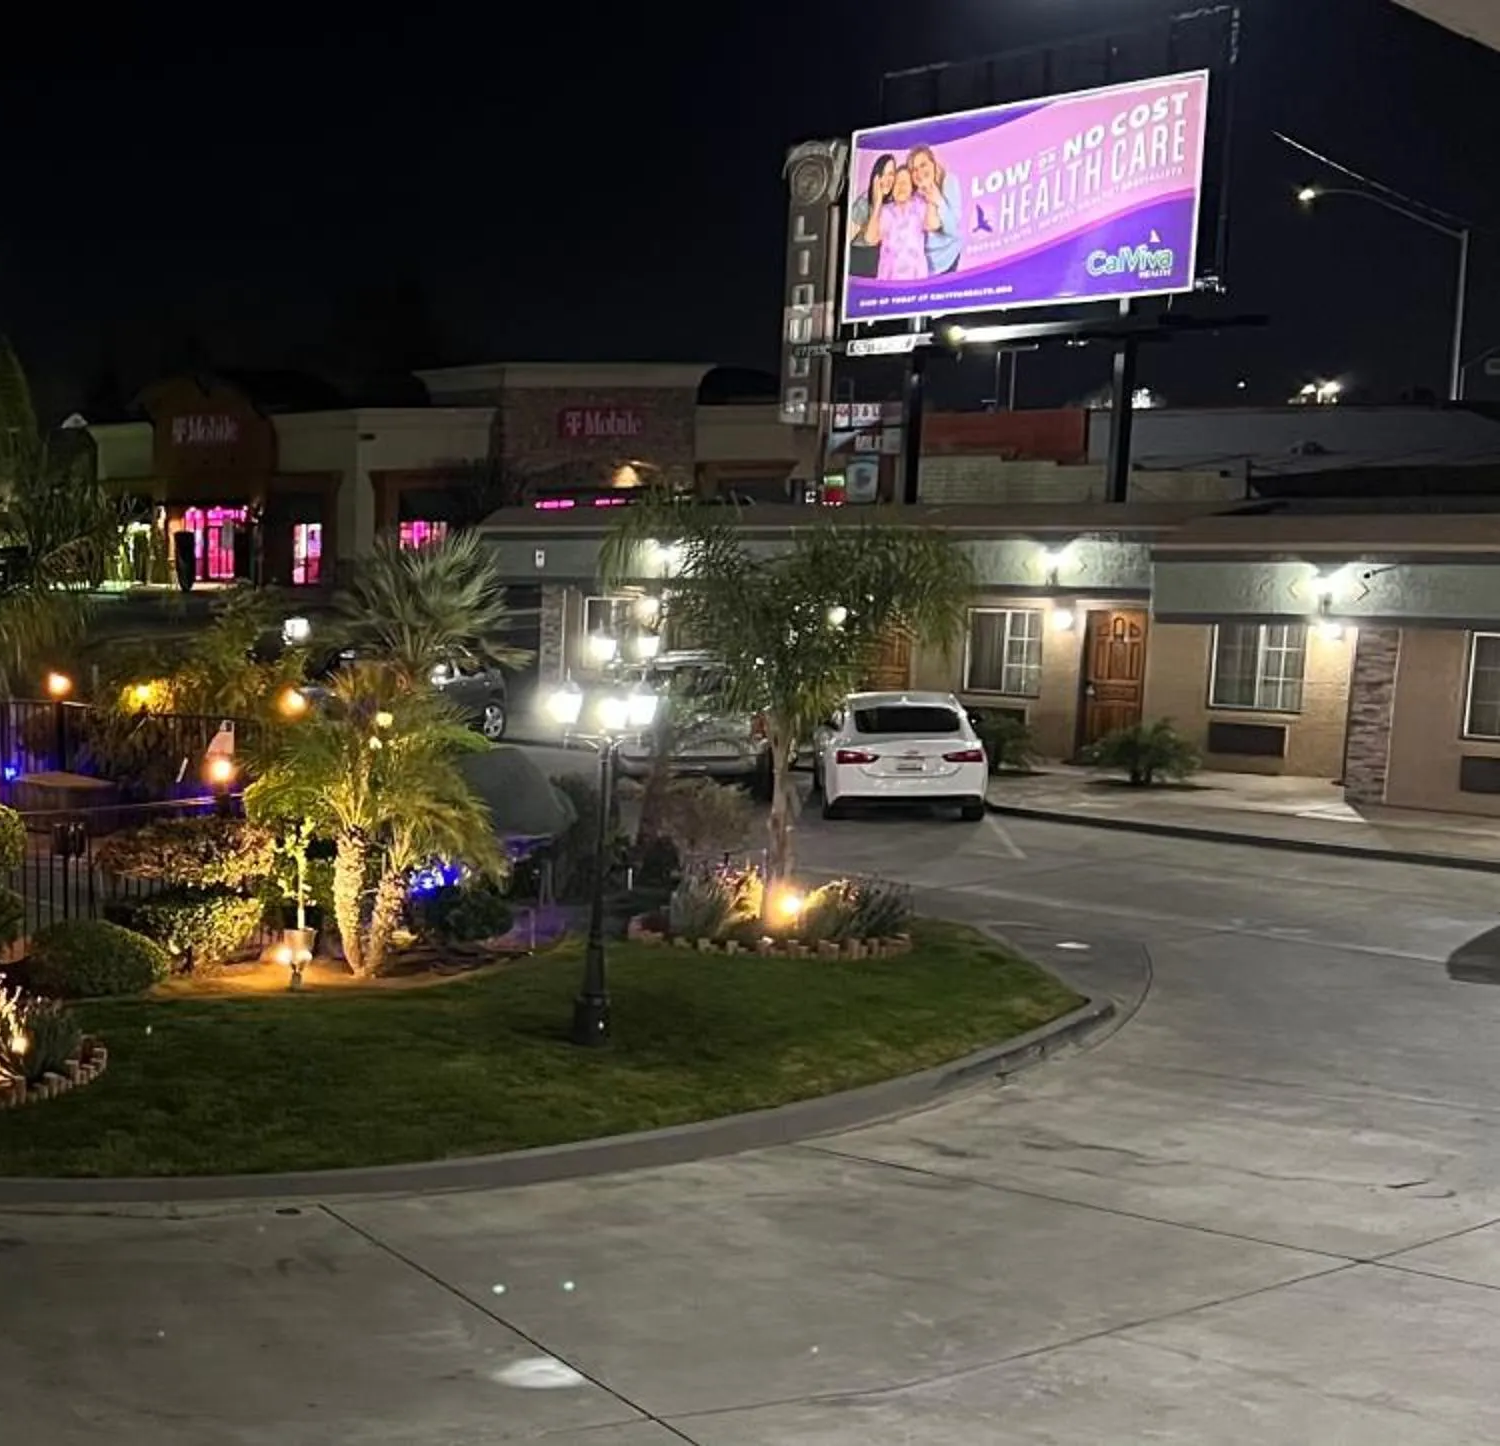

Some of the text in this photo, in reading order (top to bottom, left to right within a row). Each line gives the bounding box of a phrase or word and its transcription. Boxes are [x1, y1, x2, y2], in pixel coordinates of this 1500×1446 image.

[971, 160, 1032, 198] LOW
[1062, 125, 1105, 157] NO
[1111, 91, 1188, 137] COST
[1001, 159, 1100, 233] HEALTH
[1111, 119, 1187, 184] CARE
[1086, 244, 1173, 277] CalViva
